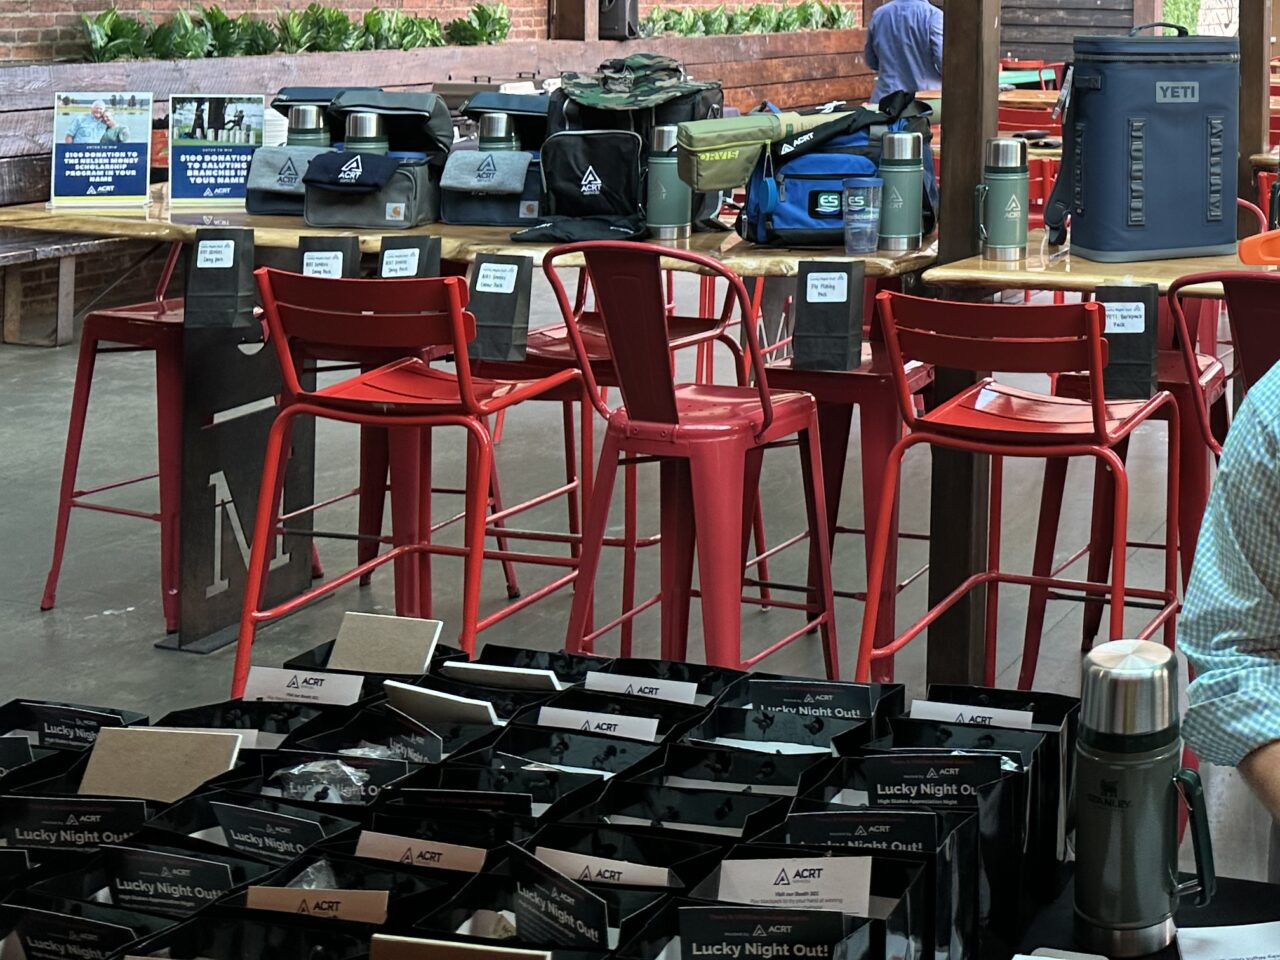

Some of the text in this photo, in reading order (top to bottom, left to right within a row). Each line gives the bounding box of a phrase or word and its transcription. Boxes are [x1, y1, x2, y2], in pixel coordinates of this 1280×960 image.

[1159, 86, 1195, 98] YETI
[793, 132, 815, 147] ACRT
[698, 150, 740, 161] ORVIS
[276, 176, 299, 184] ACRT
[337, 171, 363, 179] ACRT
[581, 184, 602, 192] ACRT
[820, 195, 839, 206] ES
[848, 196, 864, 206] ES
[301, 677, 325, 687] ACRT
[637, 686, 660, 696] ACRT
[834, 708, 860, 717] Out!
[968, 715, 994, 726] ACRT
[44, 722, 74, 738] Lucky
[594, 722, 618, 732] ACRT
[877, 783, 977, 797] Lucky Night Ou
[15, 828, 58, 844] Lucky
[60, 830, 100, 845] Night
[230, 829, 263, 847] Lucky
[264, 836, 296, 853] Night
[416, 851, 444, 863] ACRT
[596, 870, 623, 881] ACRT
[793, 868, 823, 878] ACRT
[115, 878, 155, 895] Lucky
[157, 881, 193, 898] Night
[559, 894, 576, 907] ACRT
[313, 901, 341, 912] ACRT
[517, 881, 546, 912] Lucky
[547, 900, 575, 928] Night
[576, 920, 600, 943] Out!
[768, 925, 792, 933] ACRT
[26, 936, 65, 955] Lucky
[66, 944, 102, 960] Night
[692, 942, 829, 958] Lucky Night Out!
